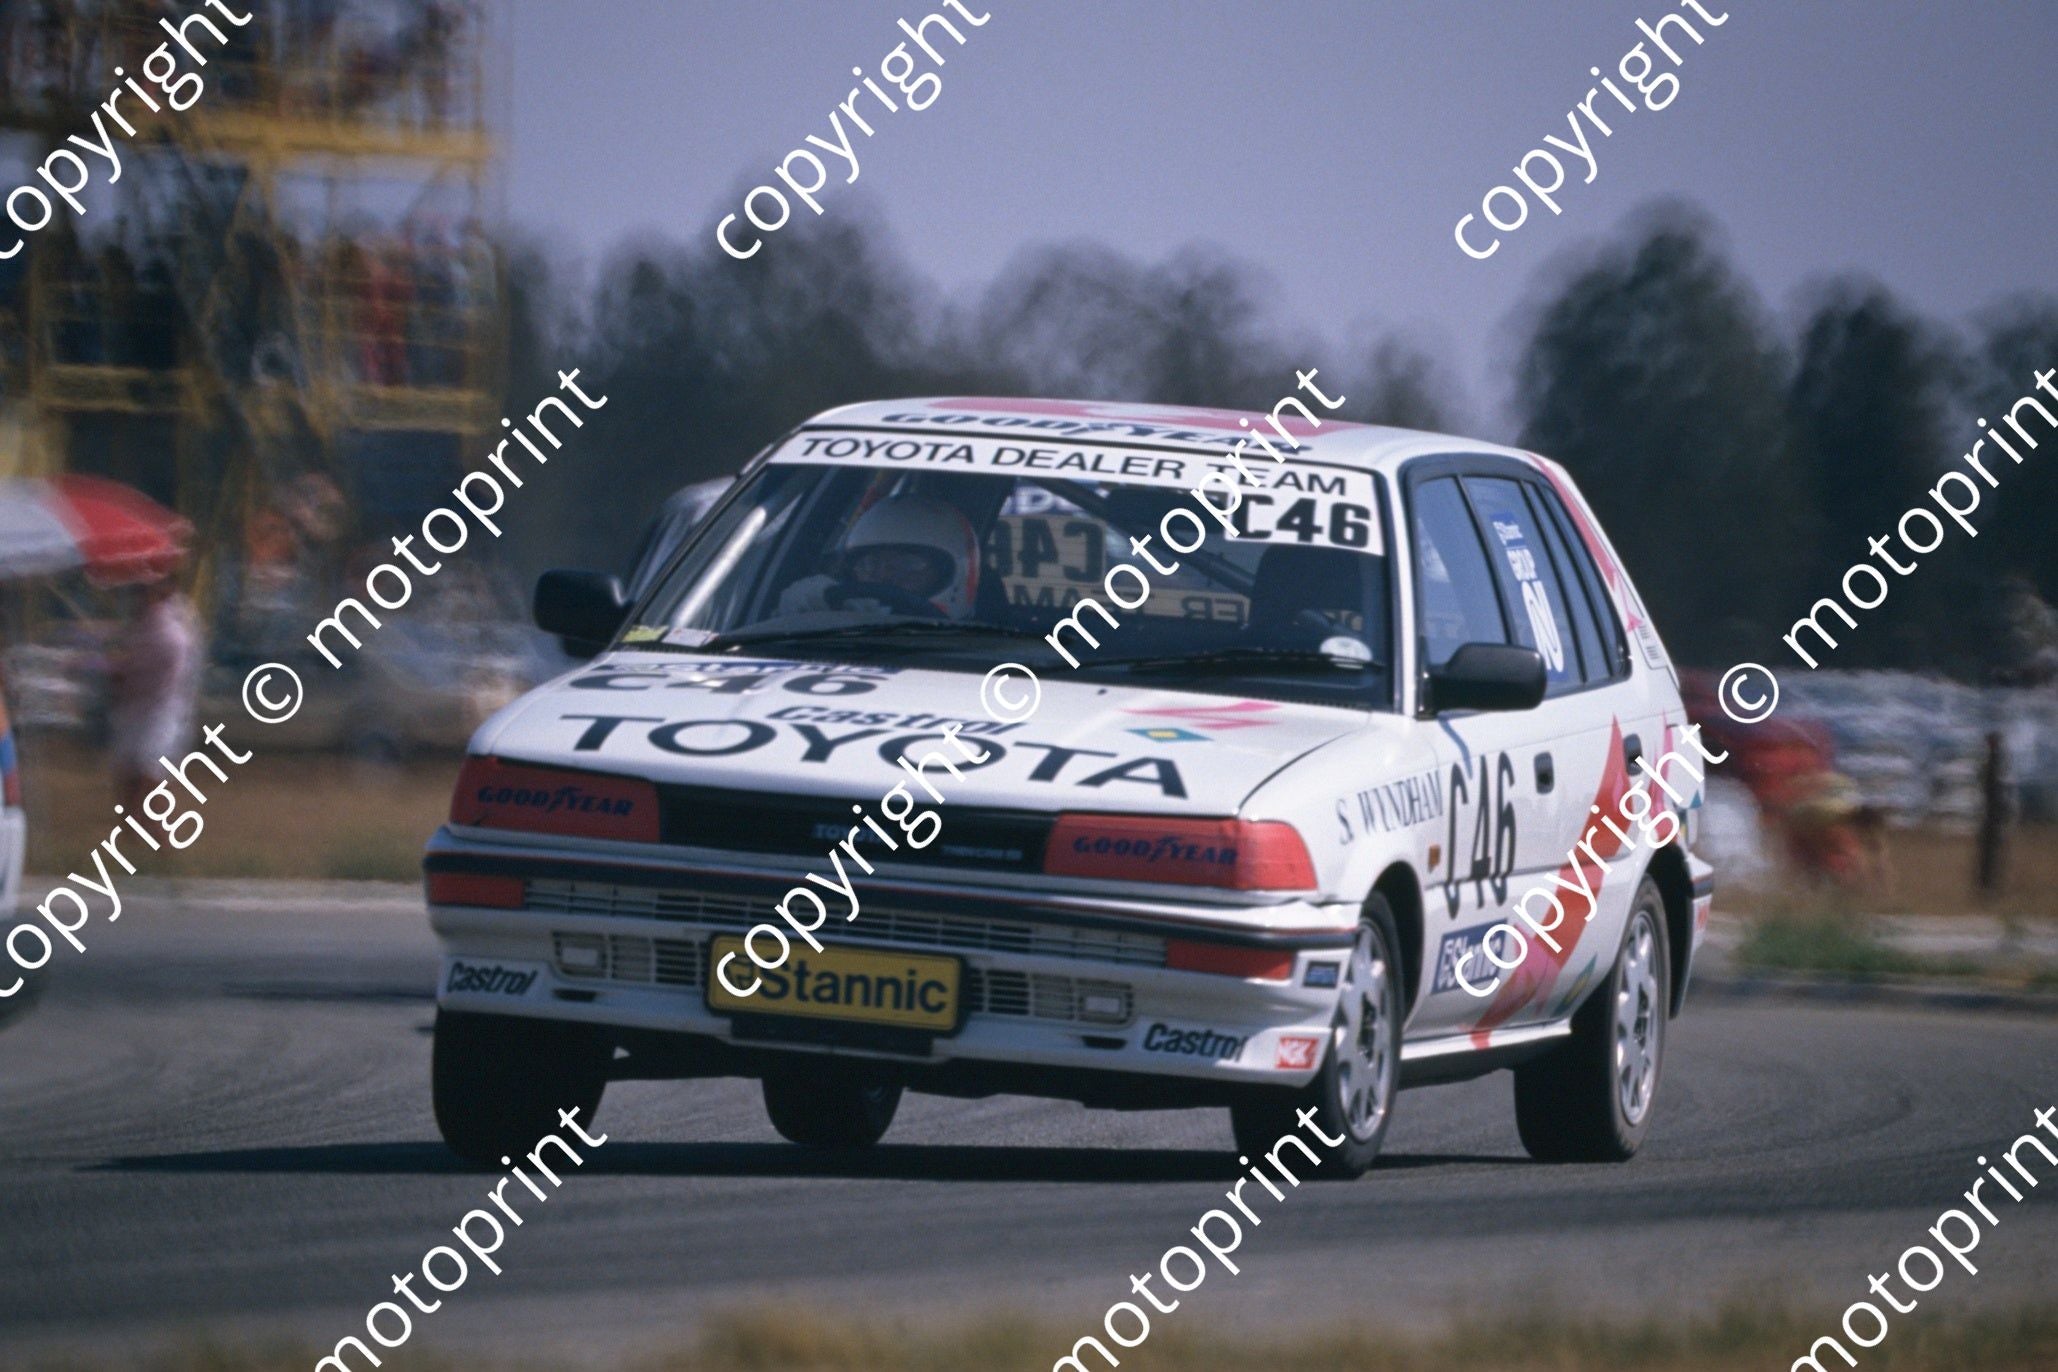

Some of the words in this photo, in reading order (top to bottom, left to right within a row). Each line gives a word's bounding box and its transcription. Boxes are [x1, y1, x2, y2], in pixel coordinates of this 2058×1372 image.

[801, 437, 974, 465] TOYOTA
[990, 446, 1186, 480] DEALER
[1207, 462, 1346, 496] TEAM
[1231, 493, 1371, 549] C46
[569, 674, 888, 696] C46
[766, 706, 1029, 735] Castrol
[560, 715, 1188, 800] TOYOTA
[477, 785, 636, 816] GOODYEAR
[1072, 834, 1239, 865] GOODYEAR
[1444, 751, 1517, 921] C46
[446, 961, 539, 995] Castrol
[757, 956, 949, 1014] Stannic
[1143, 1022, 1250, 1063] Castrol
